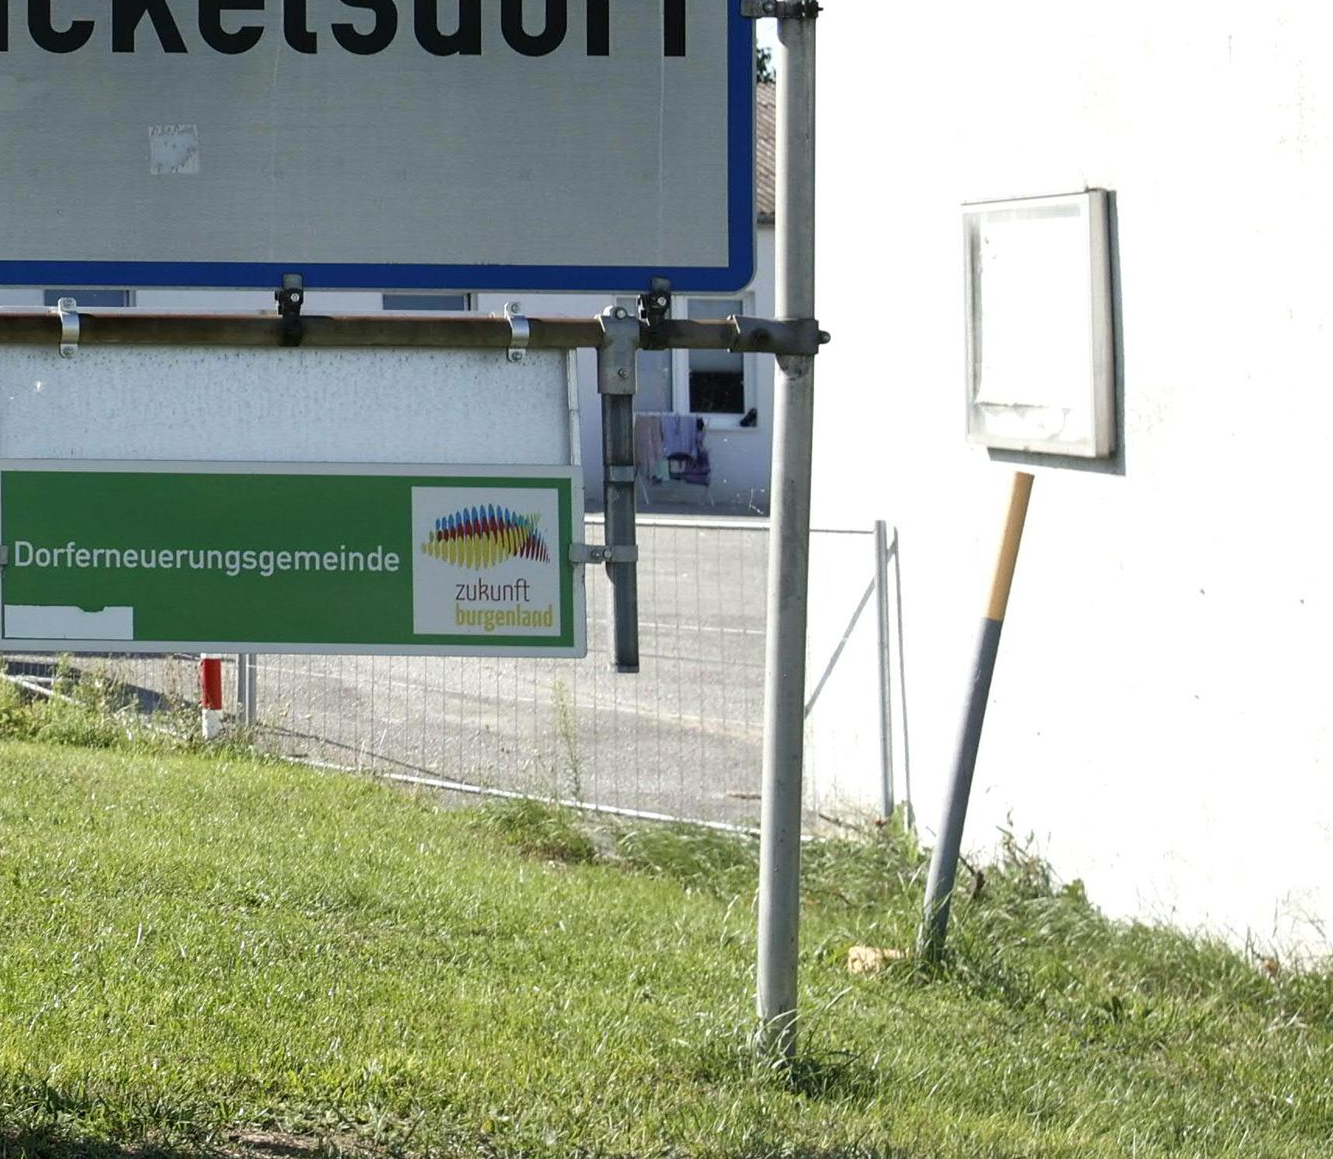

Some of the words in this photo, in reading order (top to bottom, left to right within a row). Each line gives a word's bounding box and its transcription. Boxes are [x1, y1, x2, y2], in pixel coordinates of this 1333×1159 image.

[14, 540, 400, 577] Dorferneuerungsgemeinde
[454, 578, 531, 603] zukunft
[454, 602, 554, 631] burgenland
